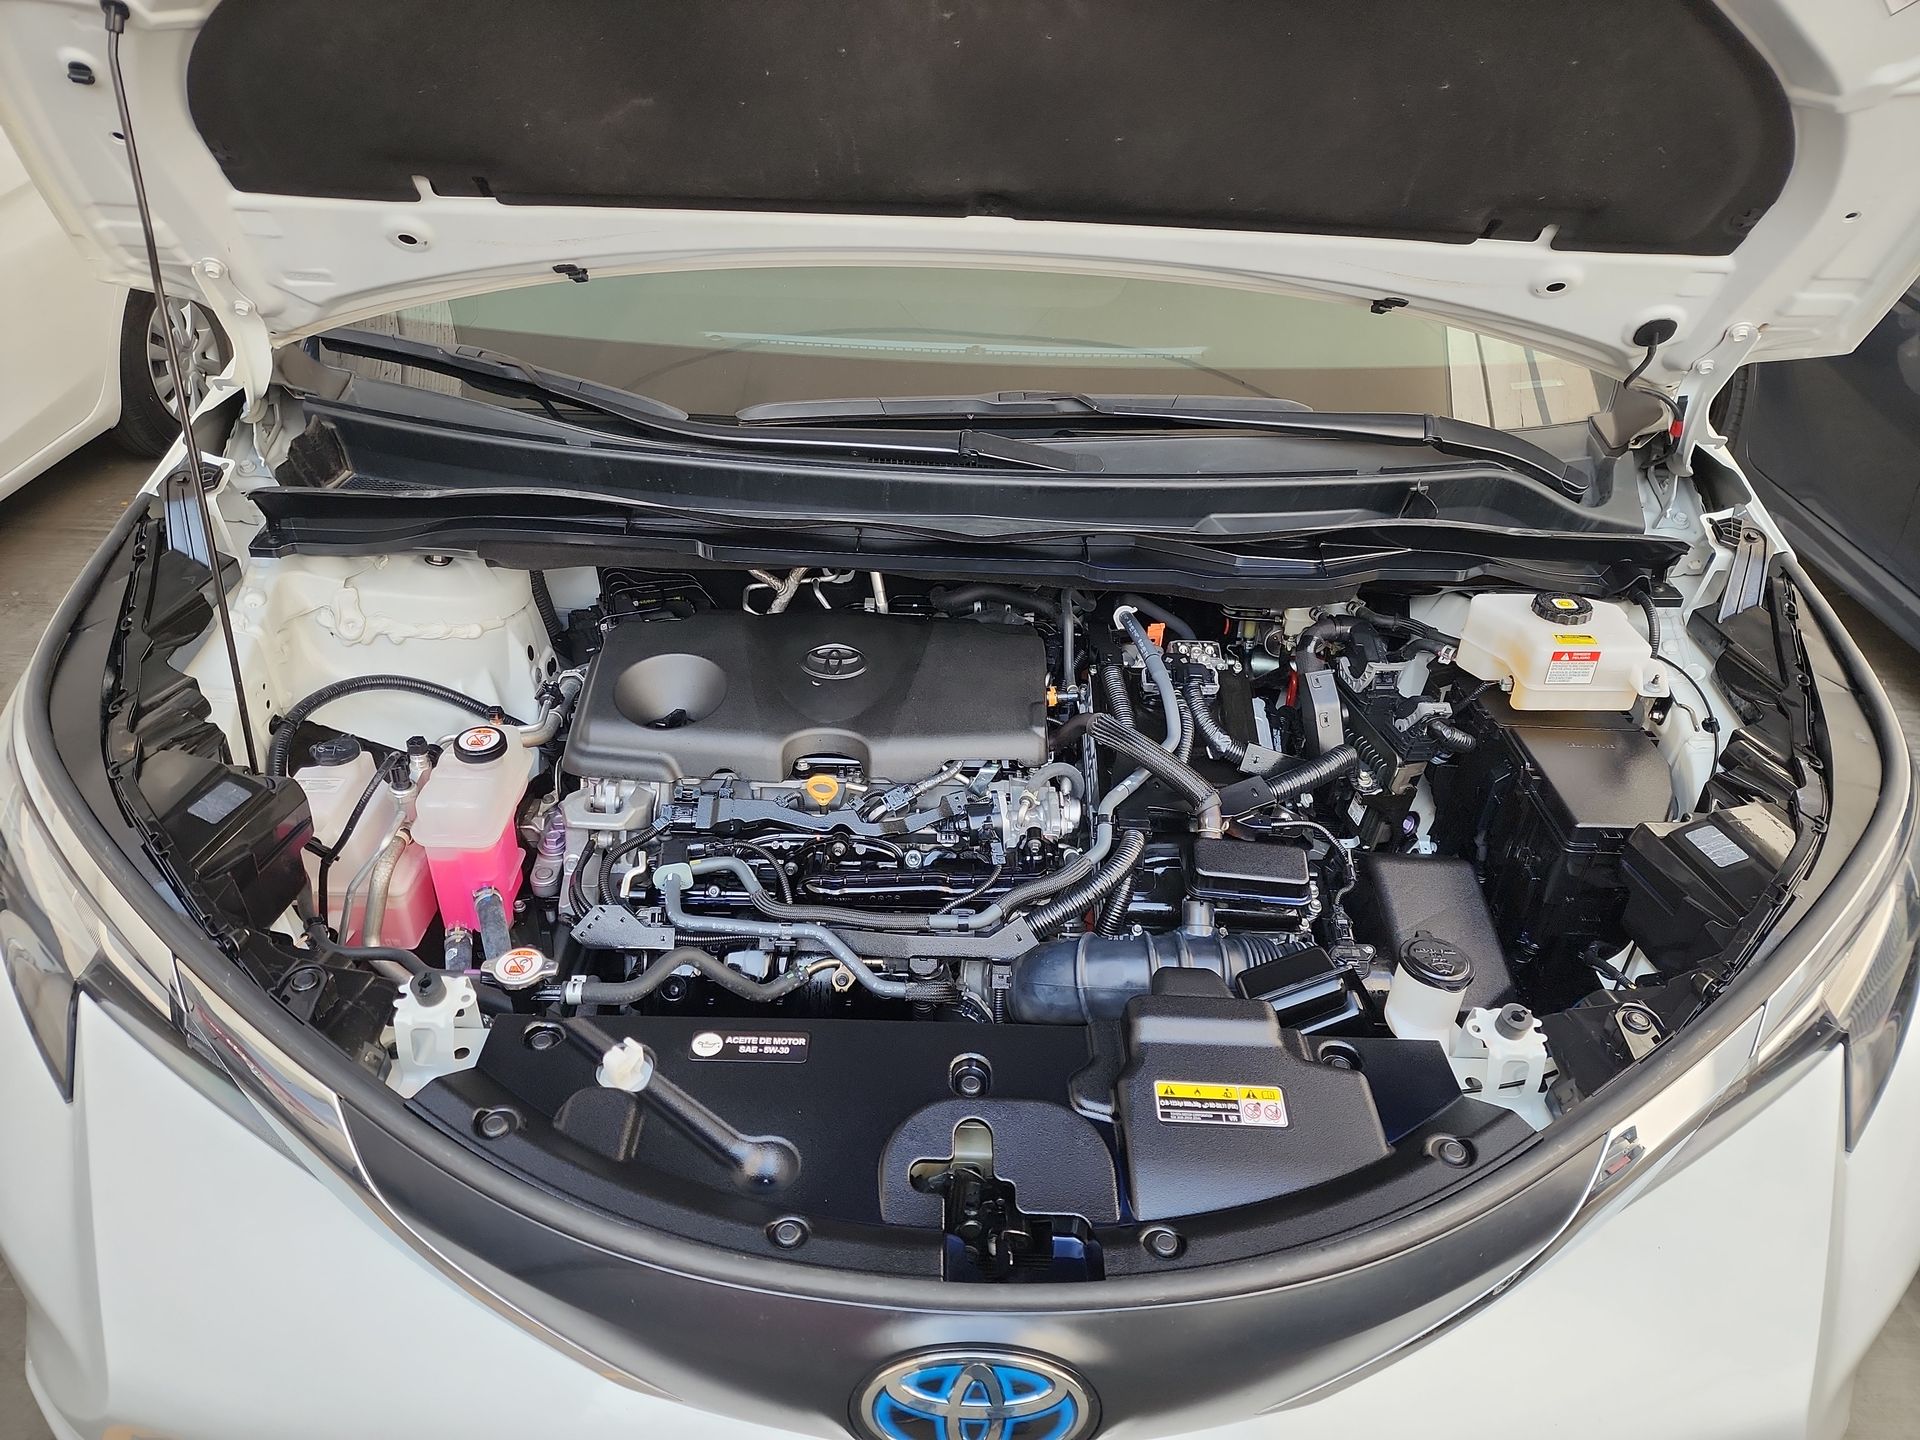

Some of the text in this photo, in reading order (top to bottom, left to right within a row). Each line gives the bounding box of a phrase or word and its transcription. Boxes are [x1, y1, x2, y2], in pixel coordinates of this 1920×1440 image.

[725, 1036, 806, 1046] ACEITE DE MOTOR
[738, 1045, 758, 1054] SAE
[763, 1046, 790, 1054] 5W-30
